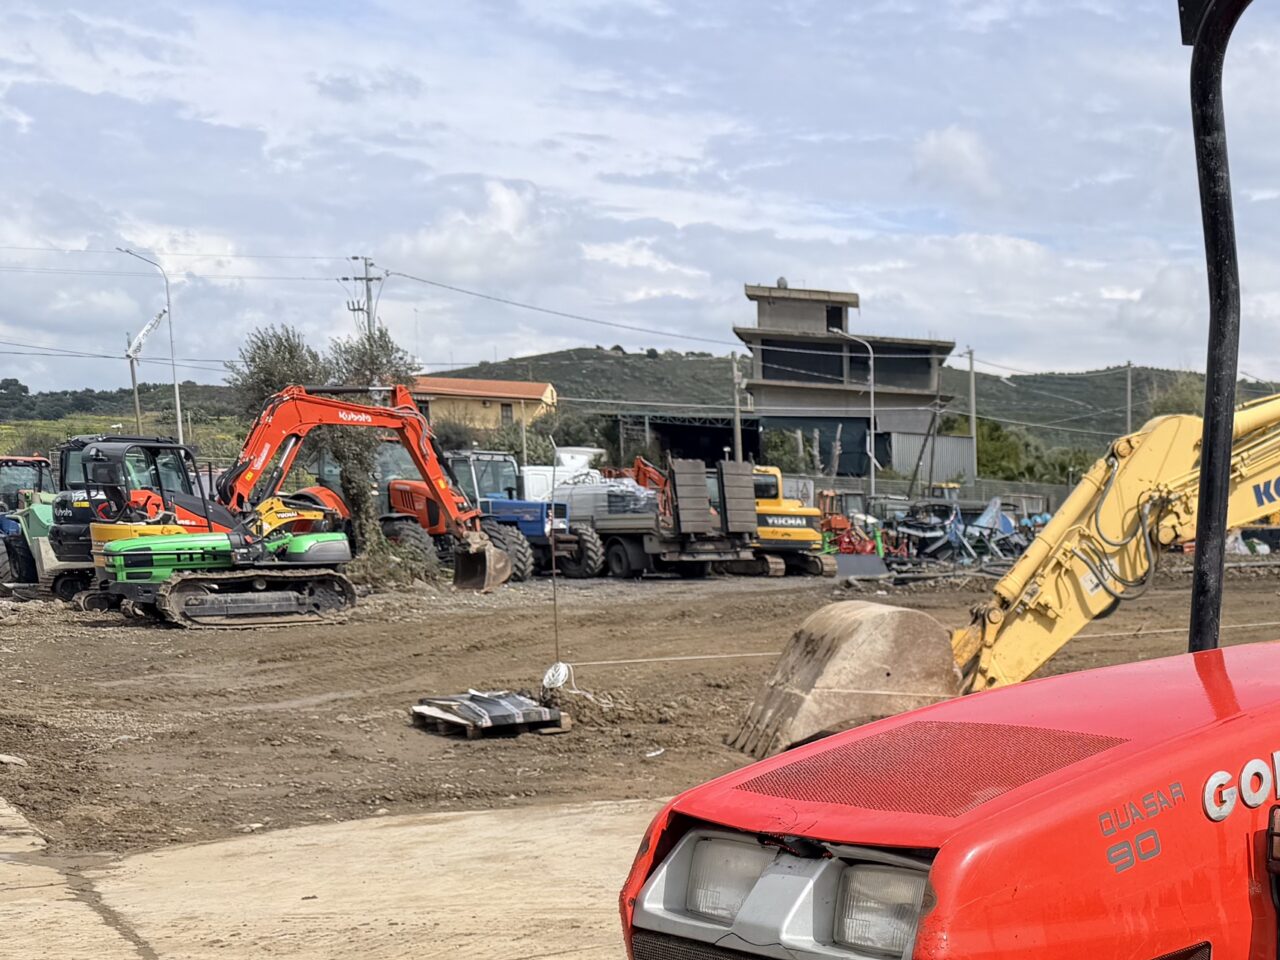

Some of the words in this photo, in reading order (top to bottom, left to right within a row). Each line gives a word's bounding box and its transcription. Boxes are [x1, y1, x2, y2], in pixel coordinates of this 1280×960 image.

[338, 411, 372, 423] Kubota
[766, 516, 807, 526] YUCHAI
[1099, 783, 1186, 837] QUASAR
[1106, 829, 1162, 873] 90
